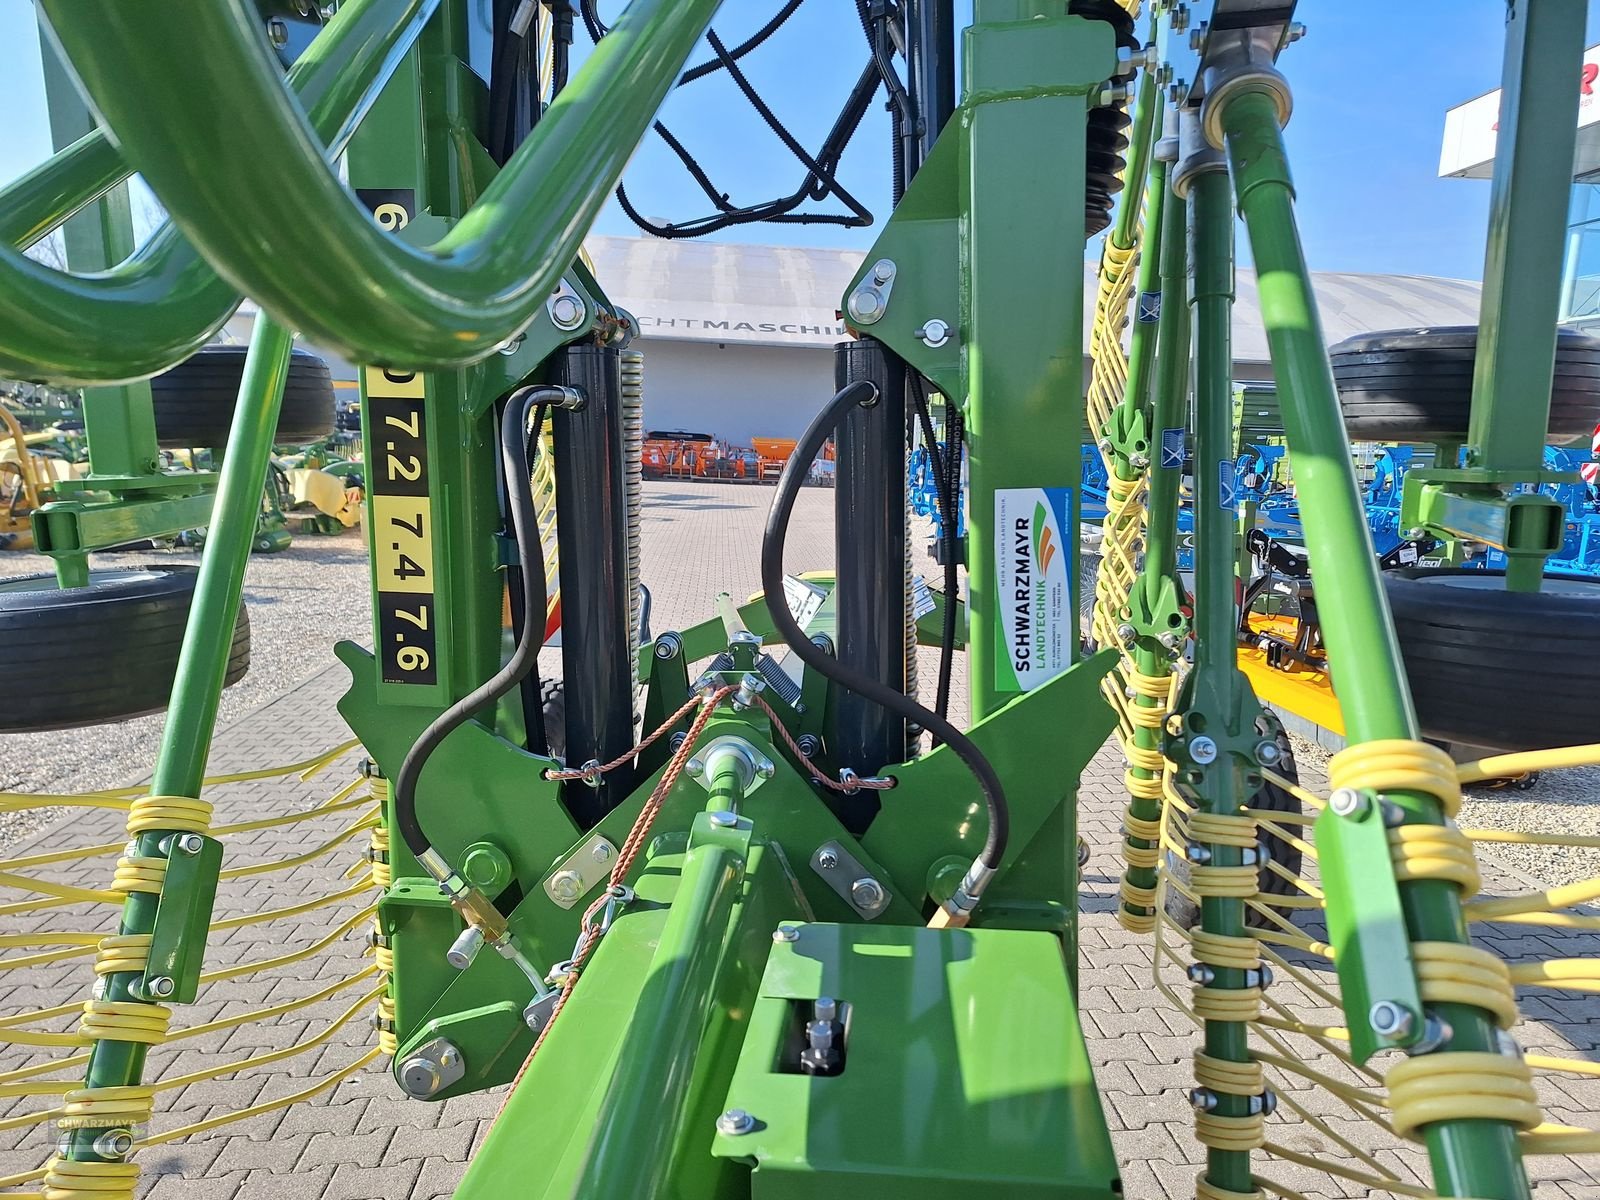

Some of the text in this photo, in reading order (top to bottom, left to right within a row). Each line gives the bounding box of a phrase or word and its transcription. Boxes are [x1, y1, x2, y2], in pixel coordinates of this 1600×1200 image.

[385, 411, 422, 481] 7.2
[951, 468, 959, 489] PLUS
[953, 425, 961, 465] COMPACT
[389, 512, 426, 580] 7.4
[1015, 518, 1030, 672] SCHWARZMAYR
[1036, 580, 1046, 669] LANDTECHNIK
[393, 604, 431, 671] 7.6
